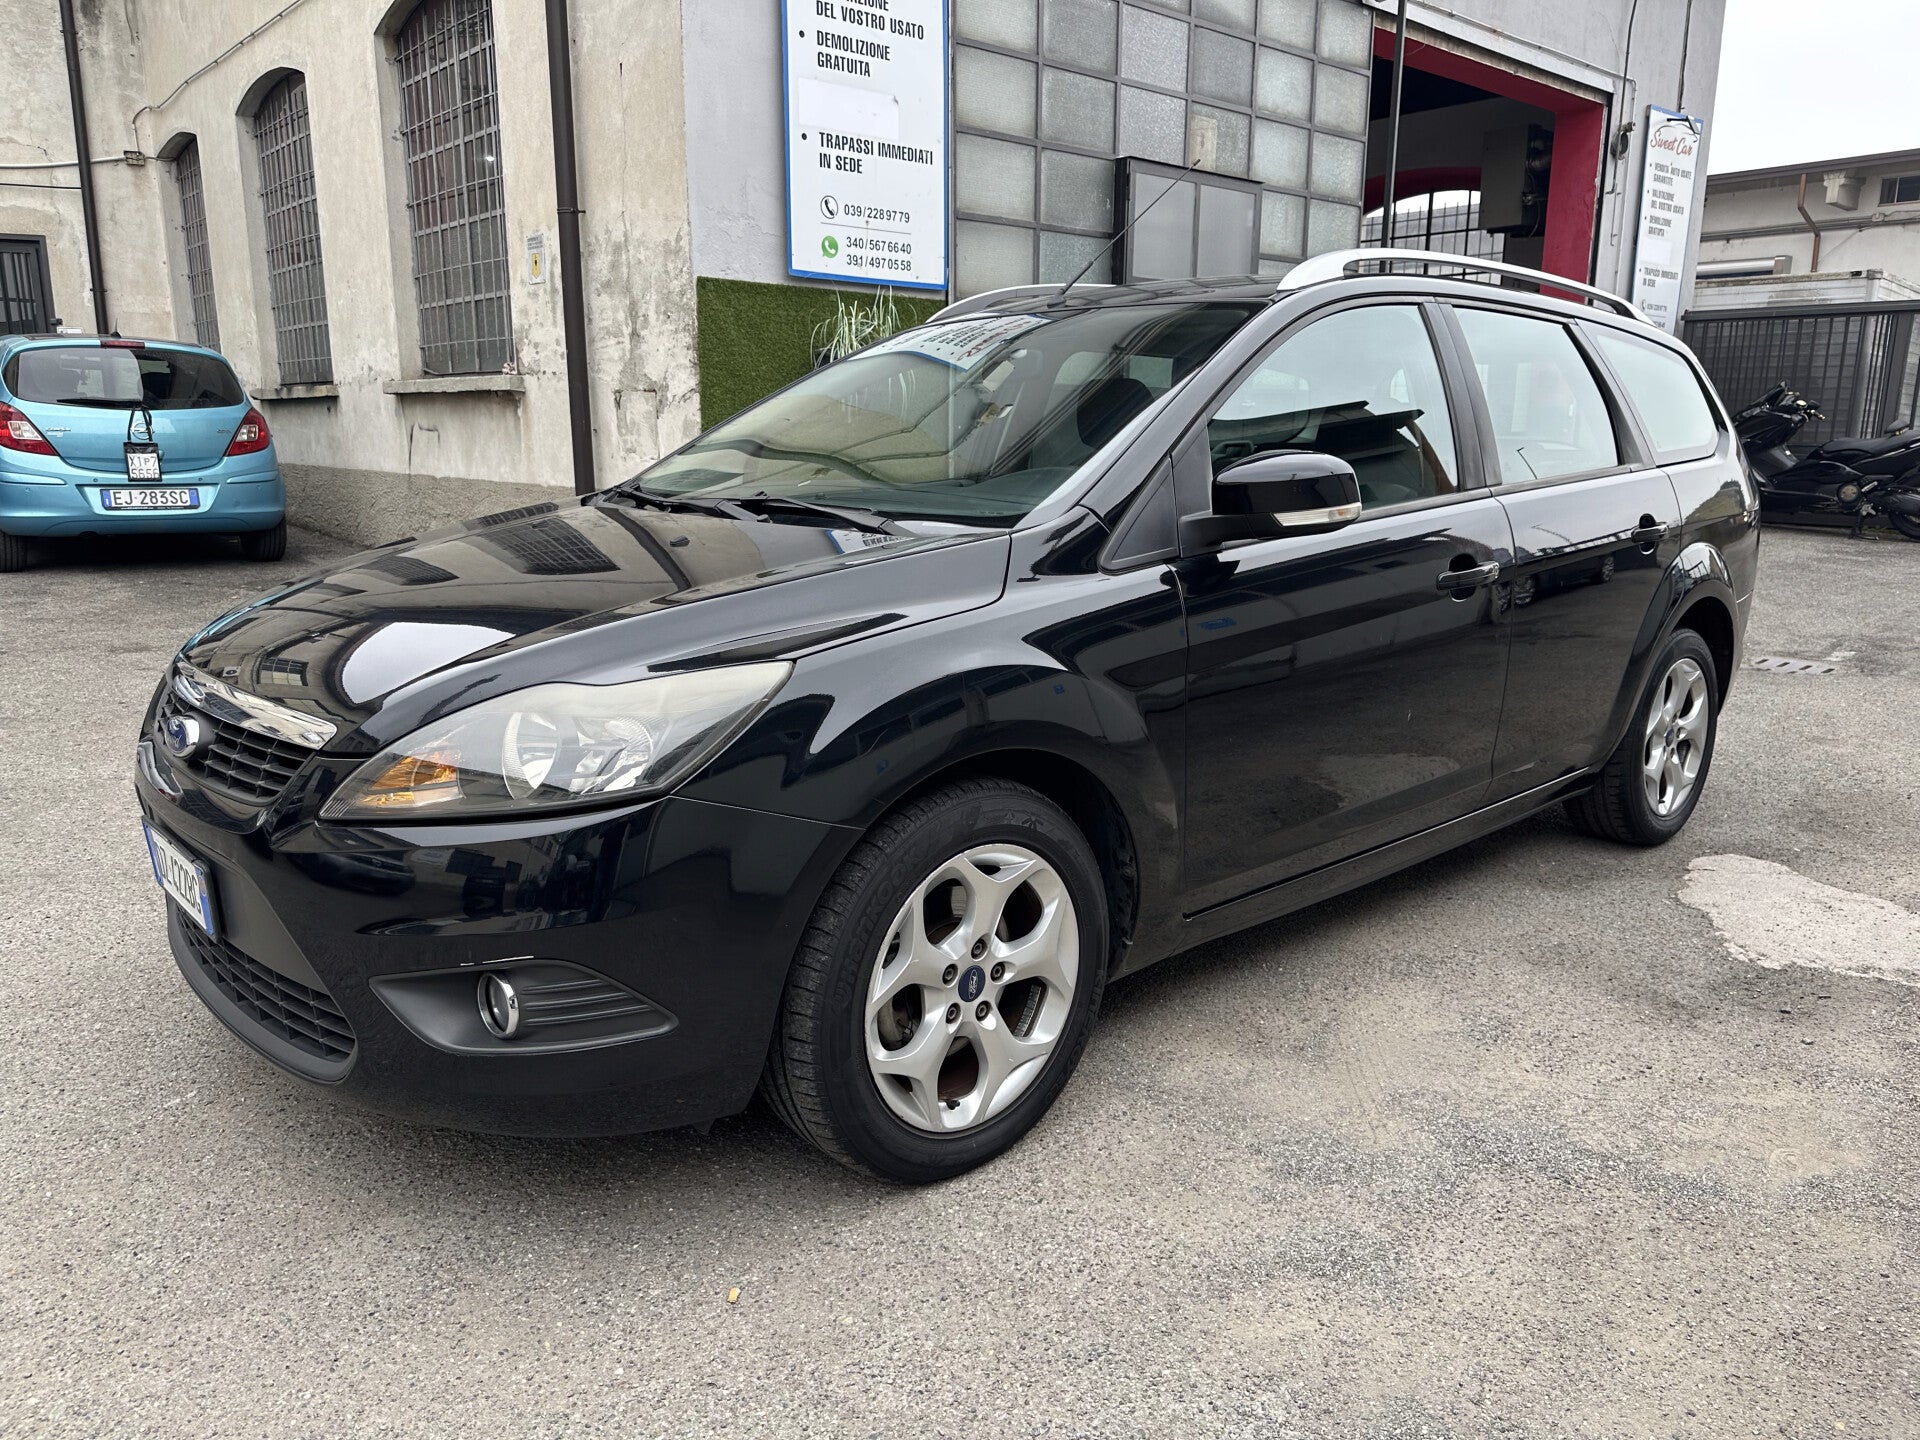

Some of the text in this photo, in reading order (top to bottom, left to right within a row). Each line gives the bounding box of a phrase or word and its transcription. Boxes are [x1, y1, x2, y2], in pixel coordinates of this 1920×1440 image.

[816, 0, 924, 40] DEL VOSTRO USATO
[816, 30, 891, 61] DEMOLIZIONE
[817, 51, 871, 77] GRATUITA
[819, 132, 933, 165] TRAPASSI IMMEDIATI
[1650, 131, 1693, 155] Sweet Car
[819, 153, 863, 174] IN SEDE
[844, 204, 910, 223] 039/2289779
[846, 236, 912, 255] 340/5676640
[846, 254, 912, 272] 391/4970558
[131, 468, 160, 479] 5656
